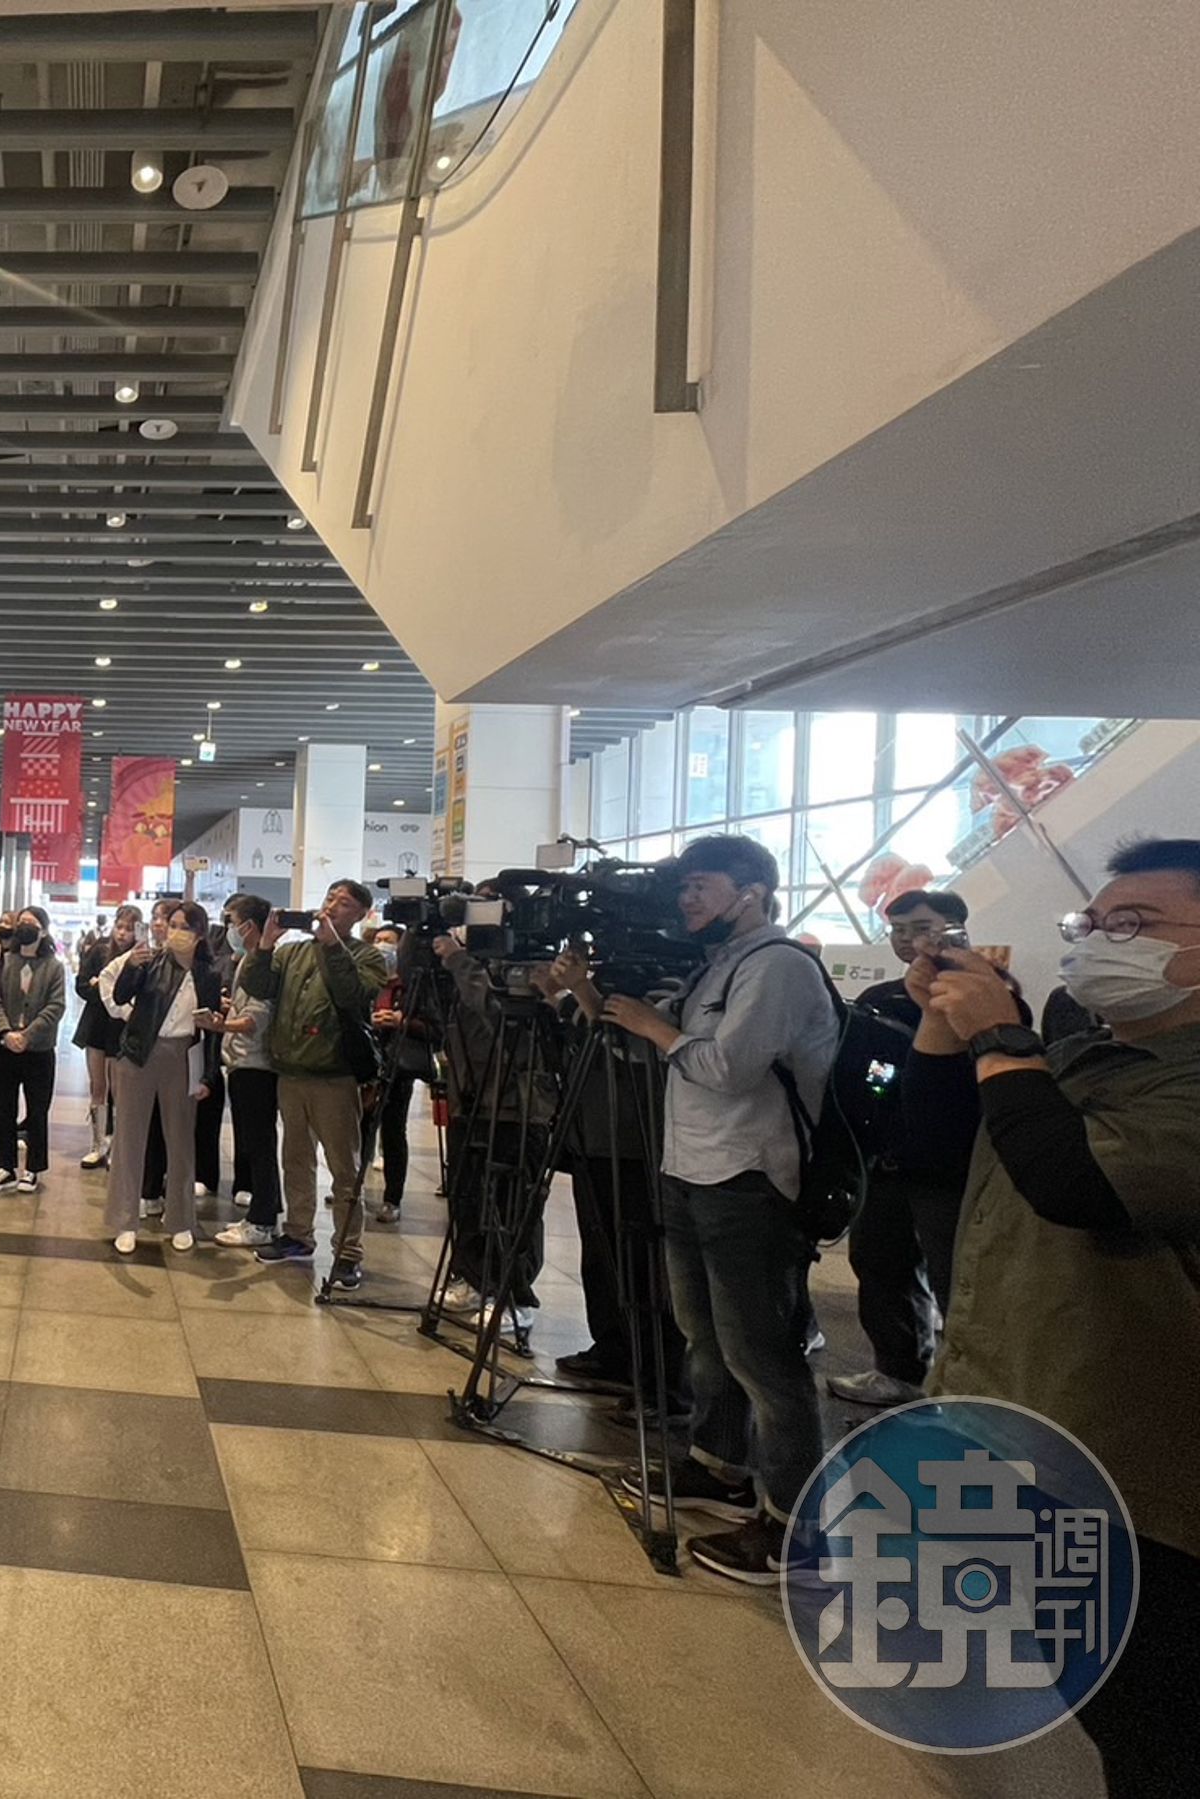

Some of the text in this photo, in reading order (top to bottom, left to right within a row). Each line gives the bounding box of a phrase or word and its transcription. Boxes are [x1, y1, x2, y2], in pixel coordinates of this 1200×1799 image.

[3, 701, 83, 719] HAPPY
[3, 719, 82, 732] NEW YEAR
